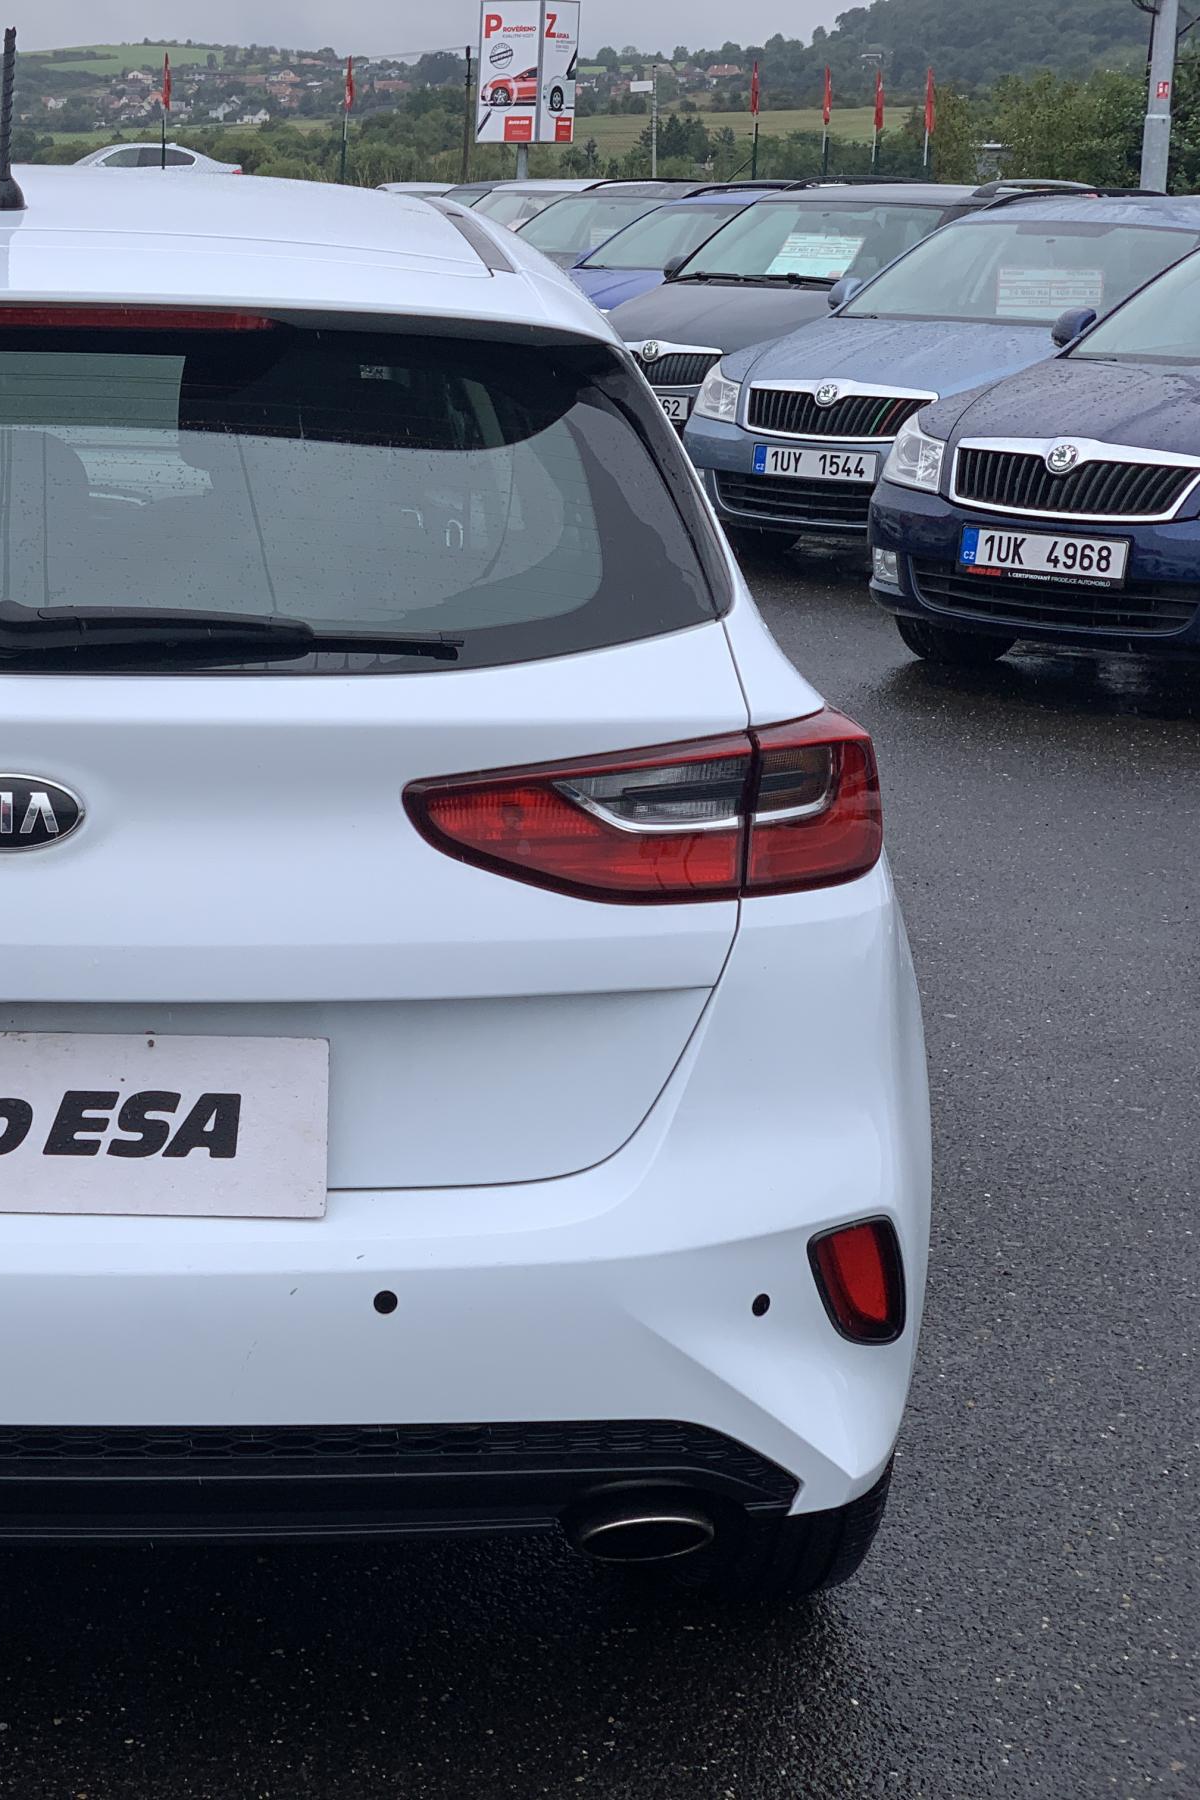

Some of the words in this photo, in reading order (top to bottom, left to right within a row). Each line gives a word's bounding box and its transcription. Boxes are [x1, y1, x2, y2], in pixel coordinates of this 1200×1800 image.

[755, 463, 765, 471] CZ
[771, 450, 803, 473] 1UY
[818, 453, 865, 479] 1544
[963, 551, 975, 560] CZ
[984, 534, 1027, 565] 1UK
[1046, 541, 1112, 573] 4968
[43, 1090, 242, 1159] ESA
